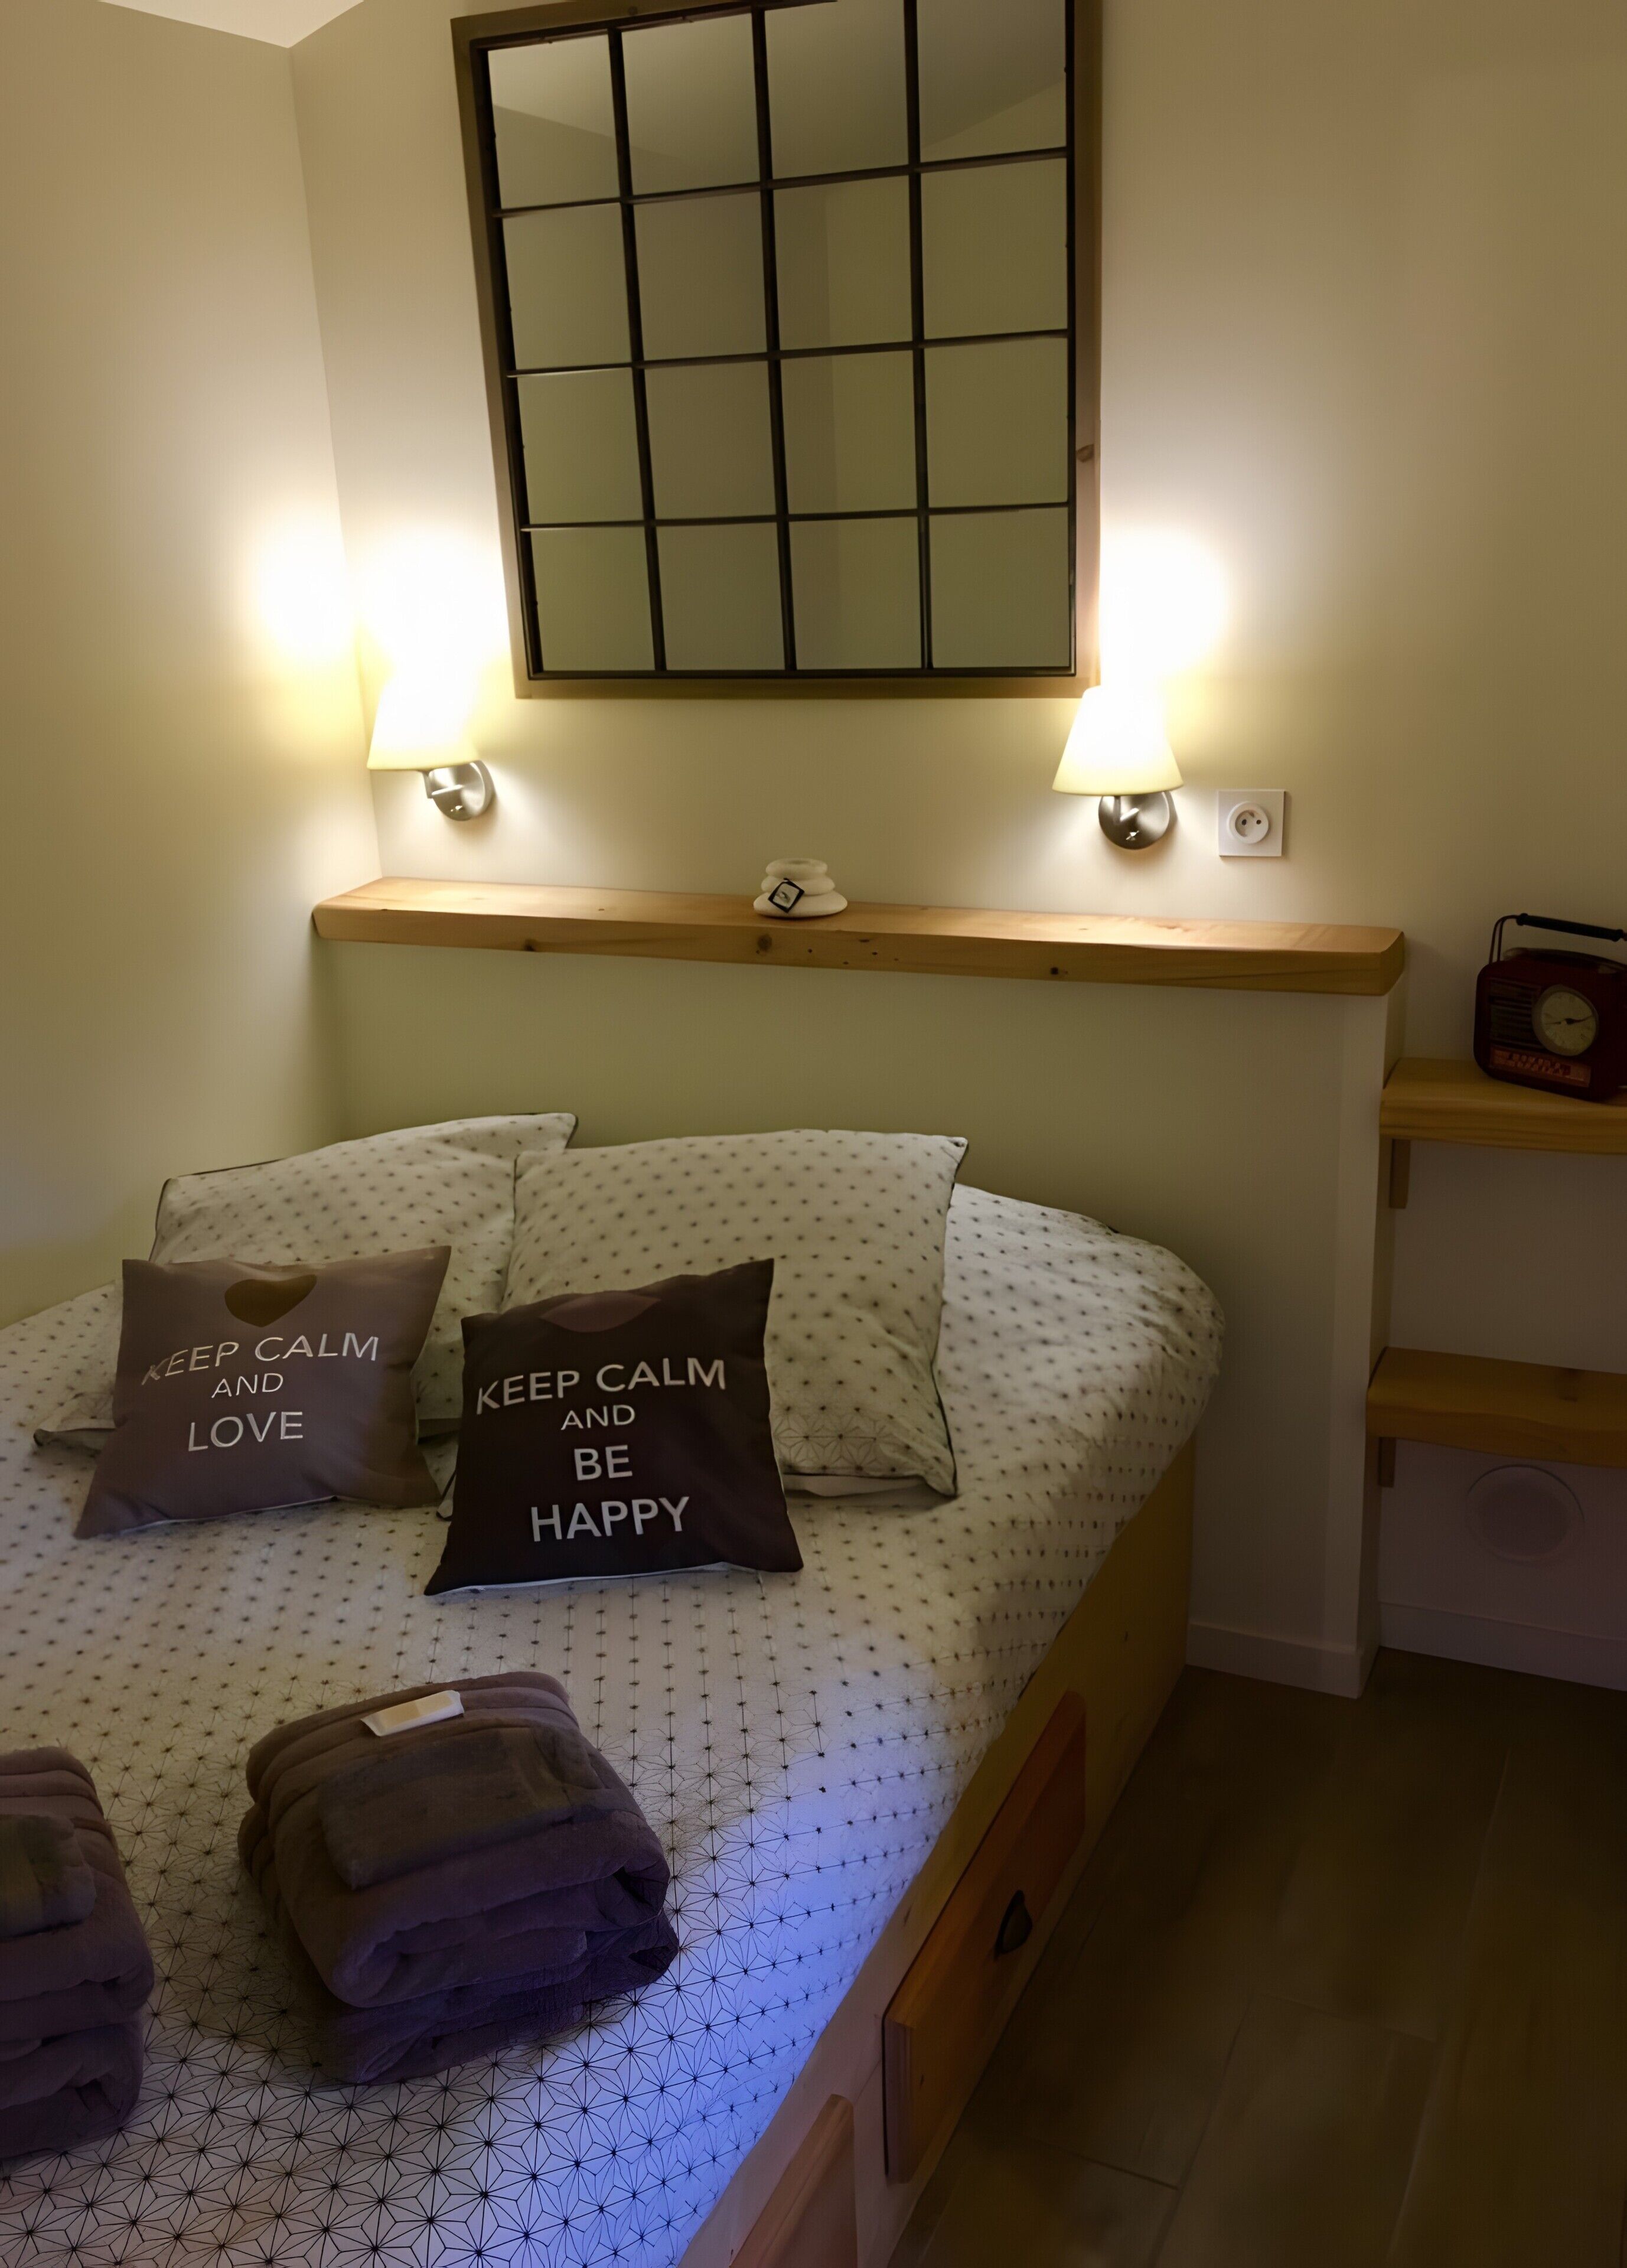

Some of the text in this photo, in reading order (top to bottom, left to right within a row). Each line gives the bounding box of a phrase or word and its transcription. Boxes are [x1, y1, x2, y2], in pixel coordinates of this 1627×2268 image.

[141, 1332, 379, 1385] KEEP CALM
[211, 1373, 283, 1398] AND
[477, 1357, 726, 1415] KEEP CALM
[188, 1411, 303, 1451] LOVE
[560, 1405, 635, 1430] AND
[574, 1445, 633, 1481] BE
[531, 1497, 689, 1542] HAPPY
